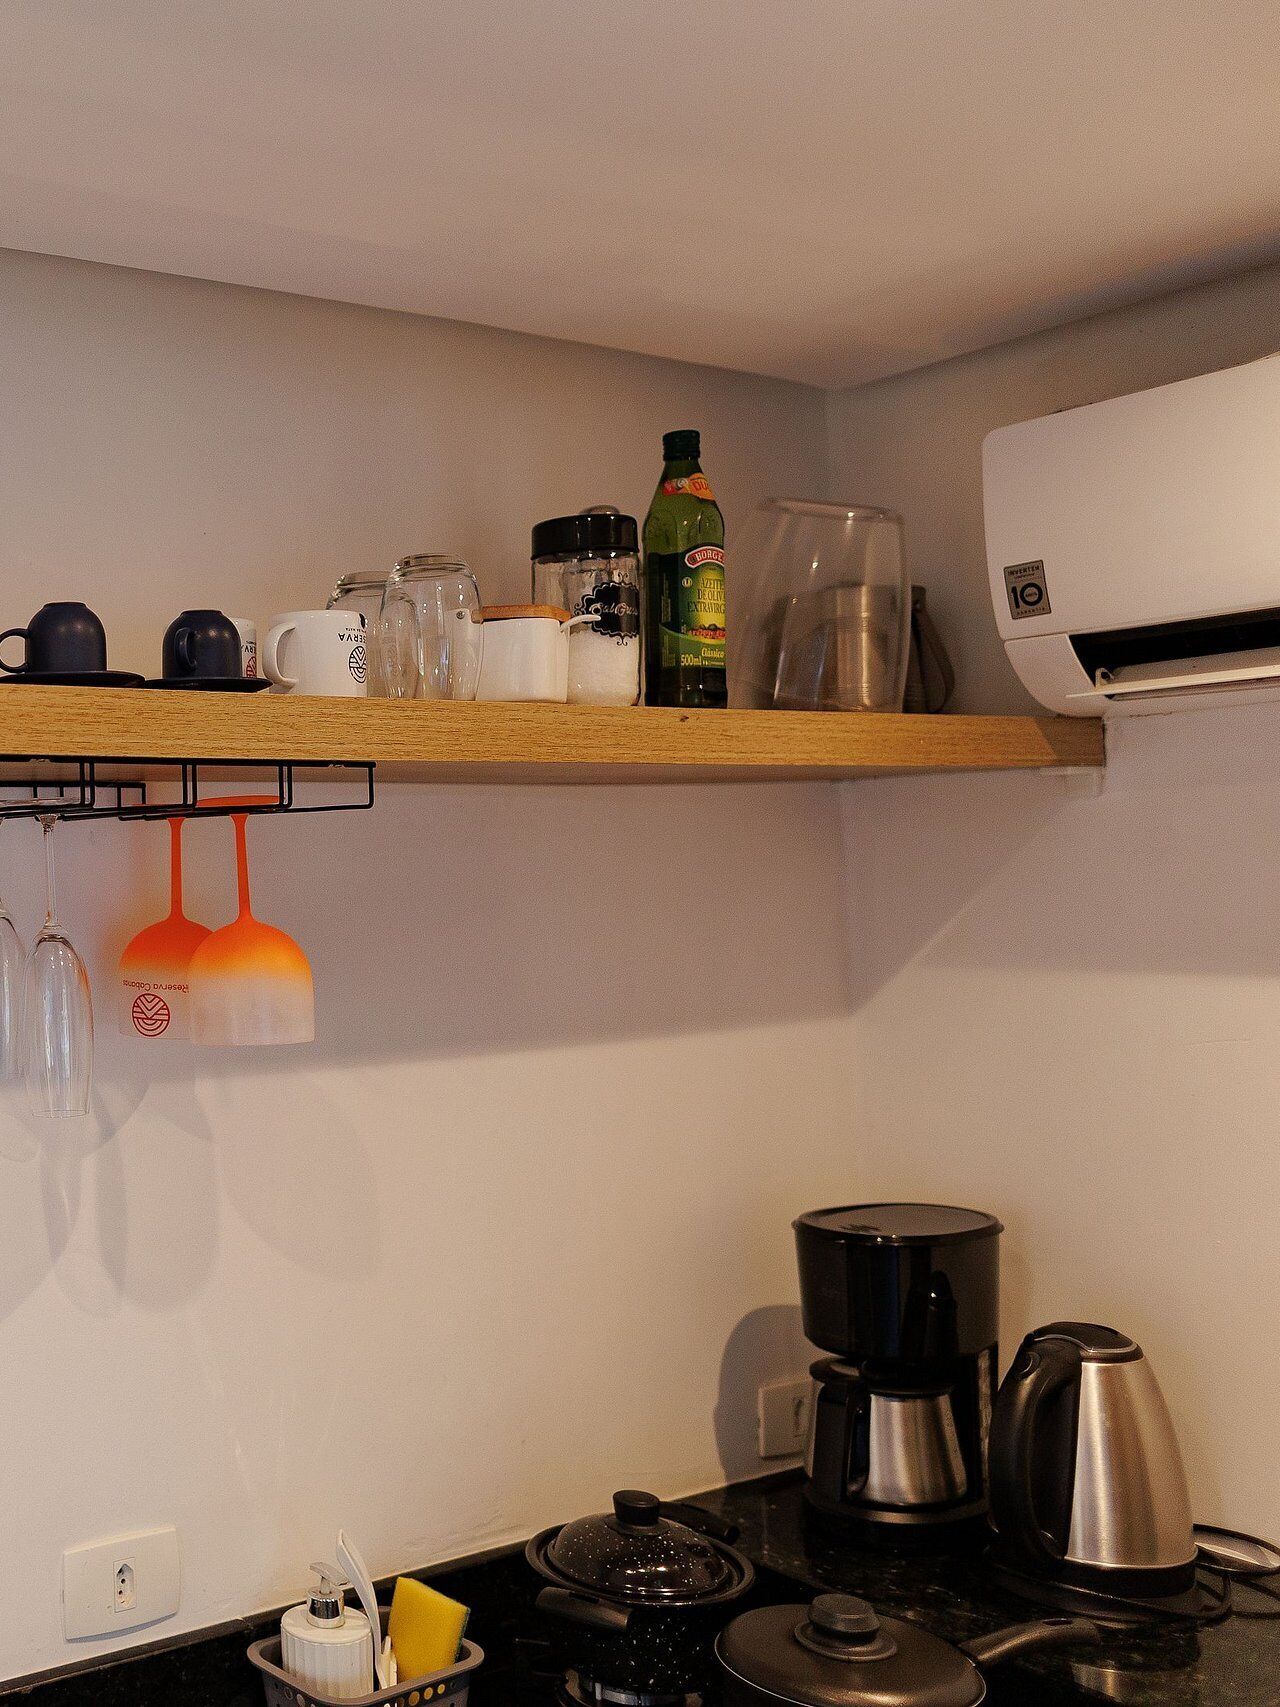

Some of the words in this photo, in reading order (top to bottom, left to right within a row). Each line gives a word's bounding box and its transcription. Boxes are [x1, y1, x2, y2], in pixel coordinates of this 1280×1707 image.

[695, 550, 724, 562] BORGE
[700, 578, 724, 590] AZEIT
[708, 590, 725, 602] OLIV
[1011, 582, 1043, 609] 10
[681, 654, 701, 666] 500ml
[153, 984, 188, 993] Reserva
